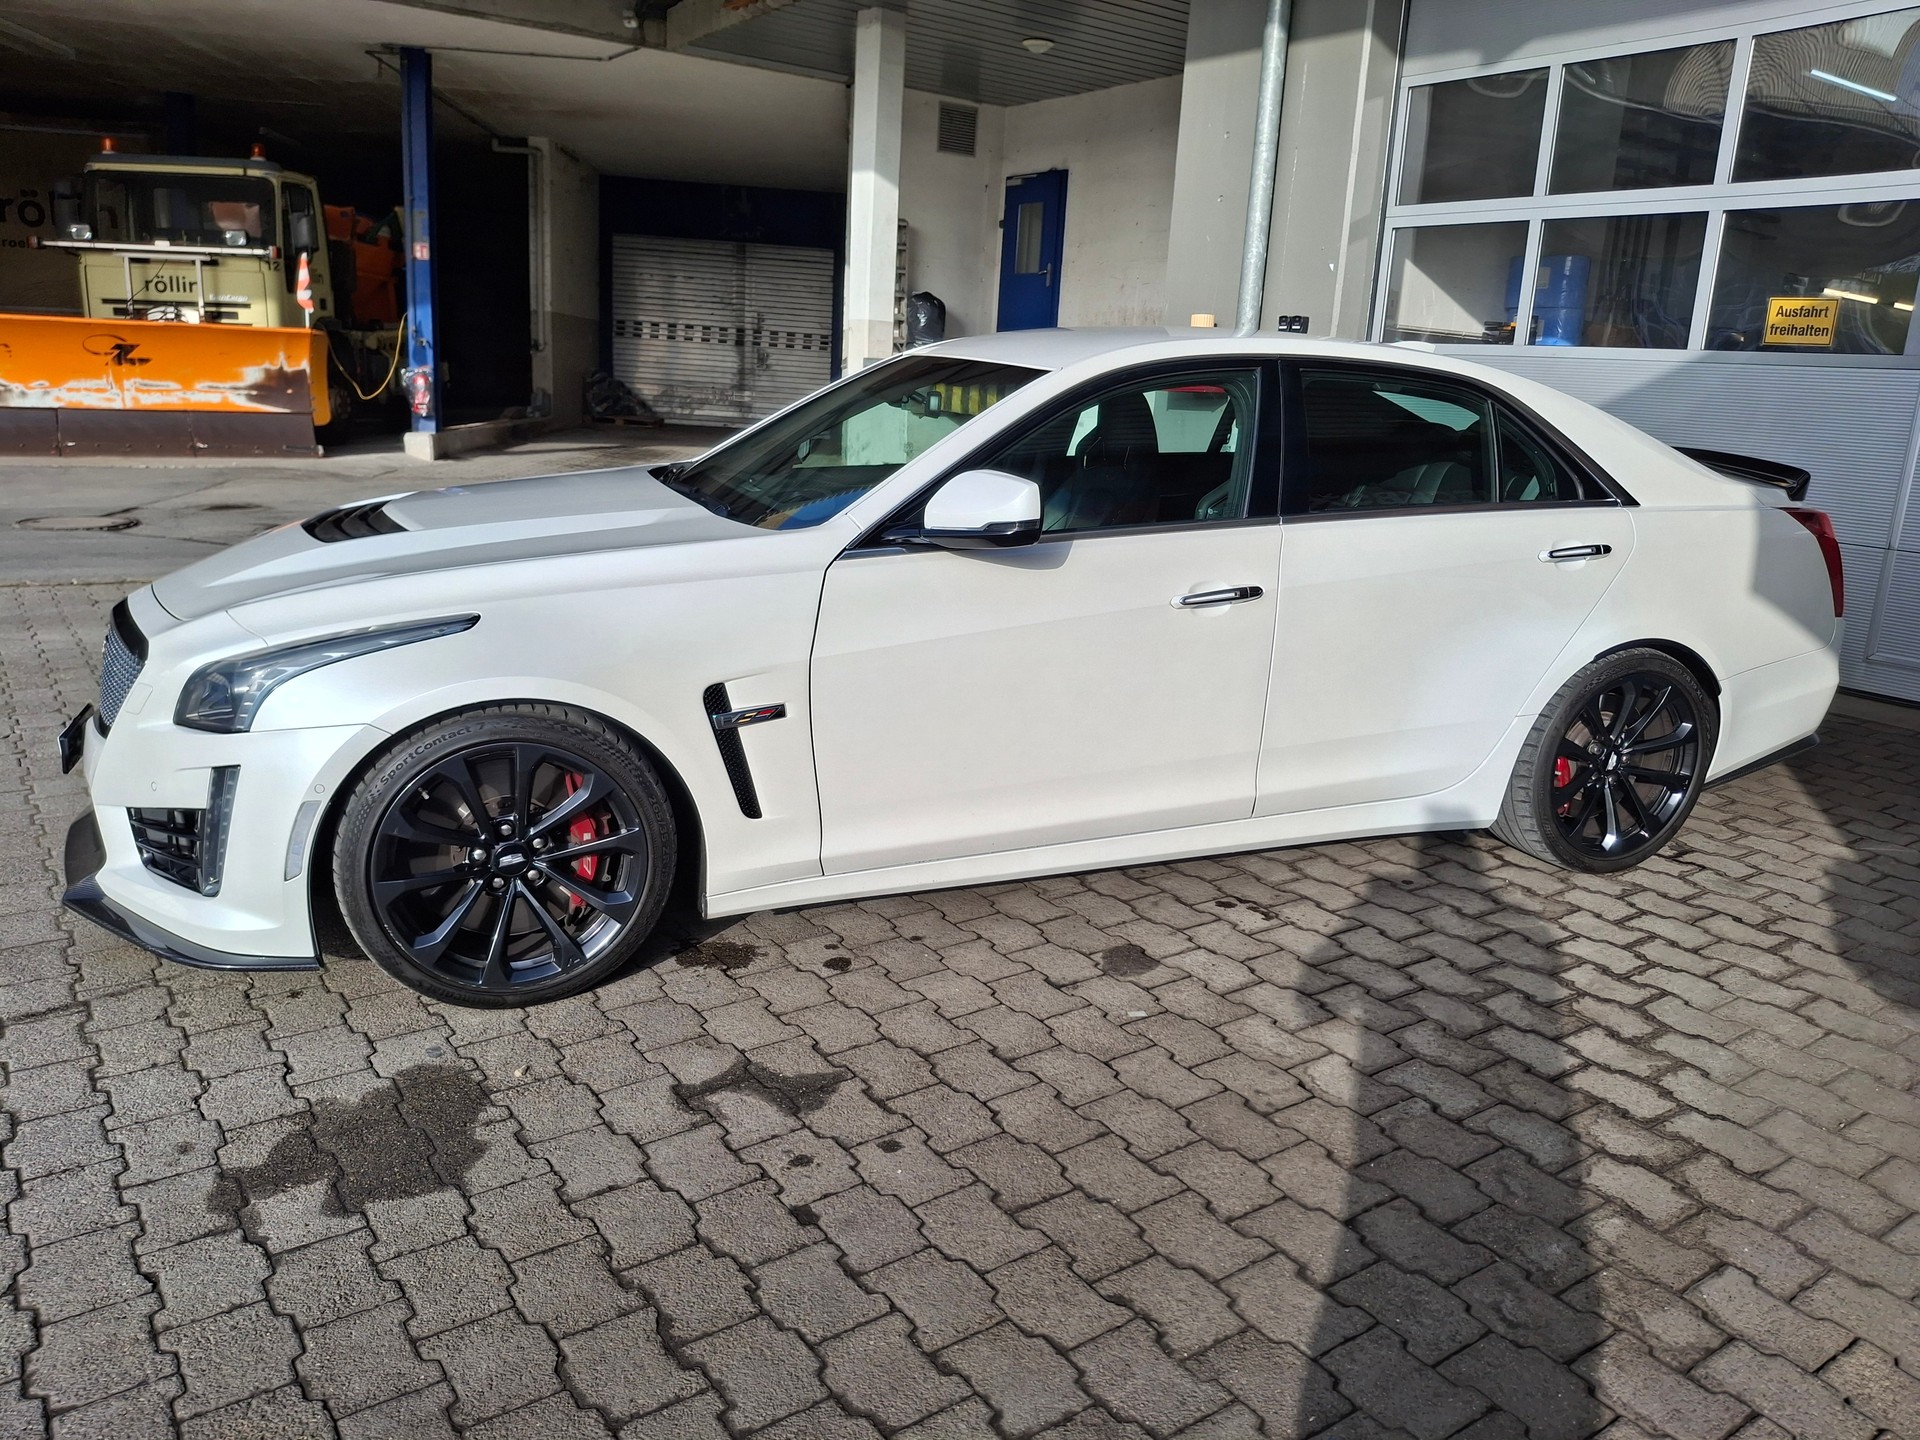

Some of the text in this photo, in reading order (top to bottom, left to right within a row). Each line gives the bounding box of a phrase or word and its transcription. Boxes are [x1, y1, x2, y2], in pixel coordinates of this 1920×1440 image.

[1775, 305, 1829, 318] Ausfahrt
[1769, 323, 1829, 337] freihalten
[379, 725, 472, 786] SportContact
